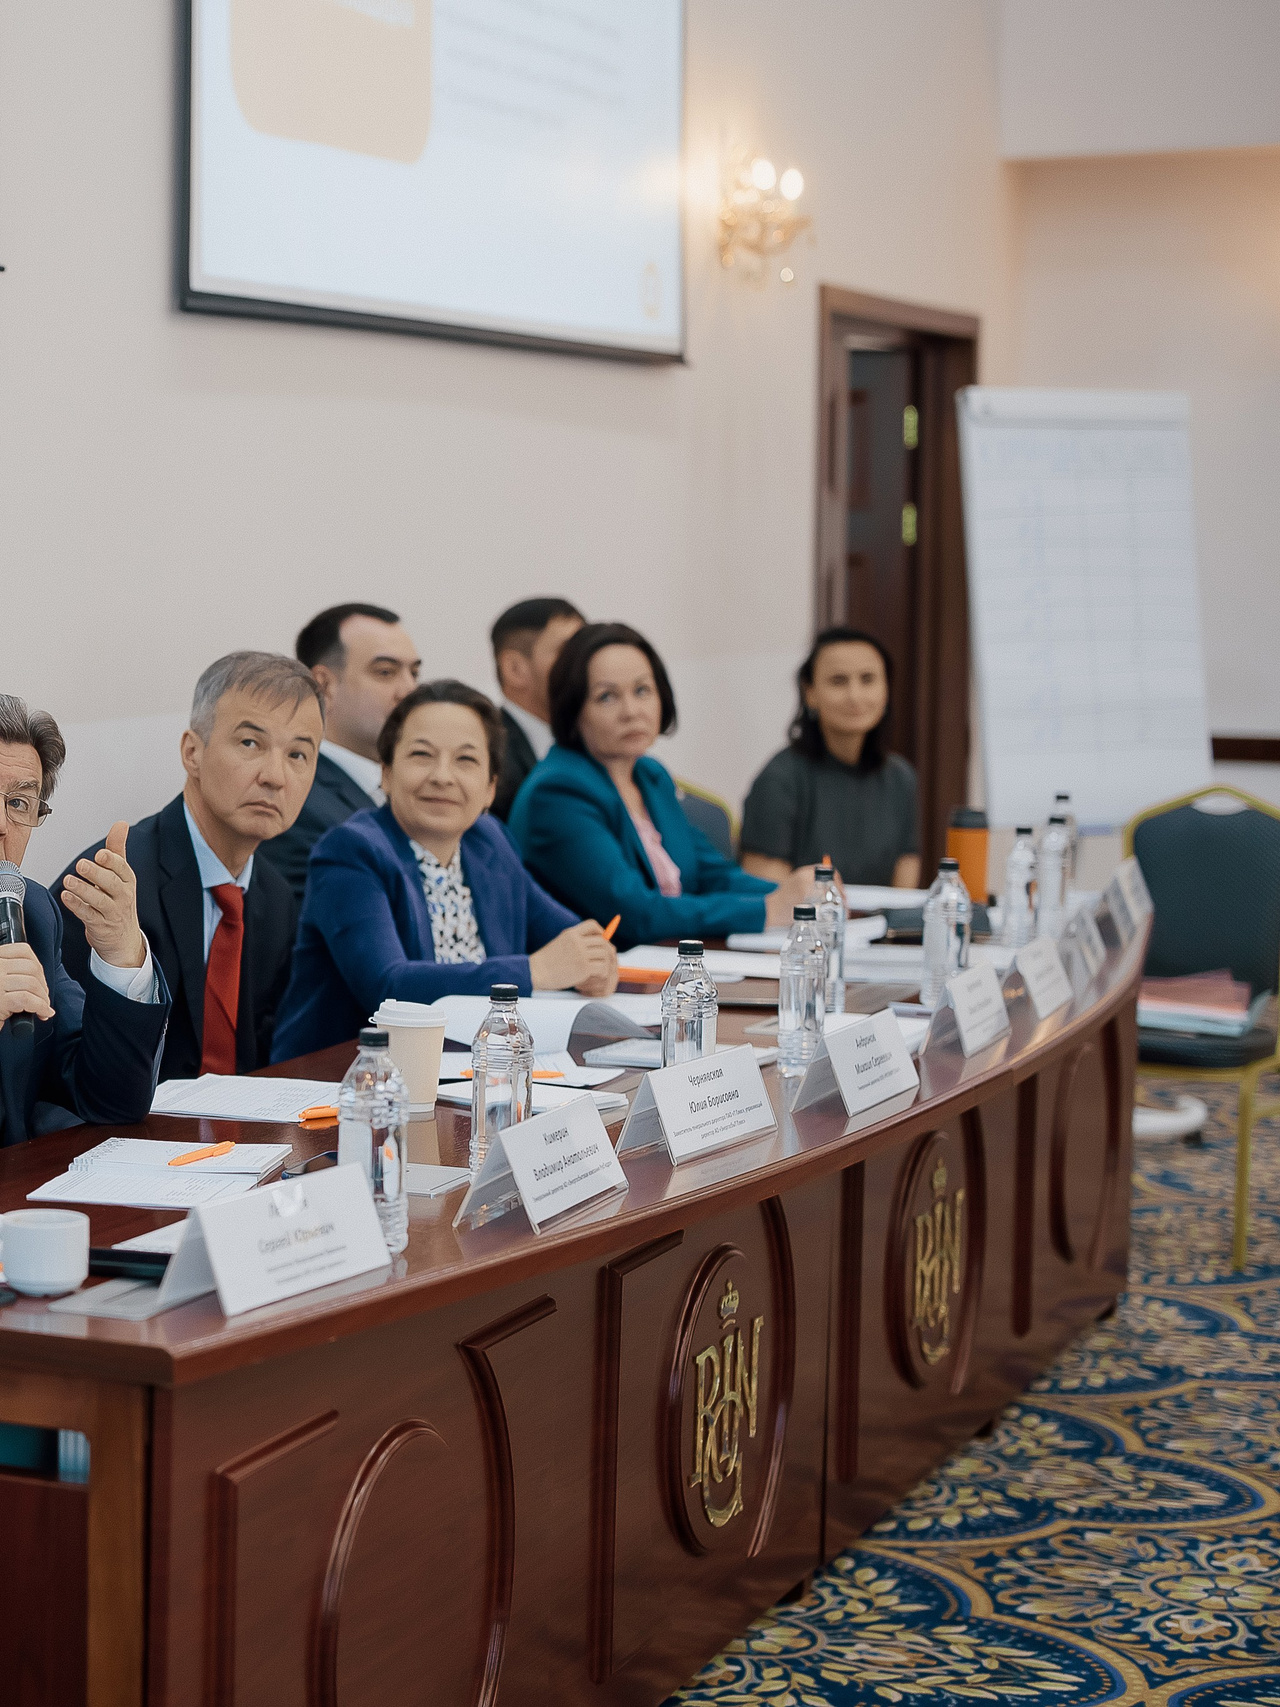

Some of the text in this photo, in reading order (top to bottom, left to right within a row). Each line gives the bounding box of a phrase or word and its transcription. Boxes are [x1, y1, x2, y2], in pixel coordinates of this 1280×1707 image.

[687, 1068, 724, 1087] Чернявская
[688, 1089, 740, 1114] Юлия Борисовна
[533, 1143, 599, 1181] Владимир Анатольевич
